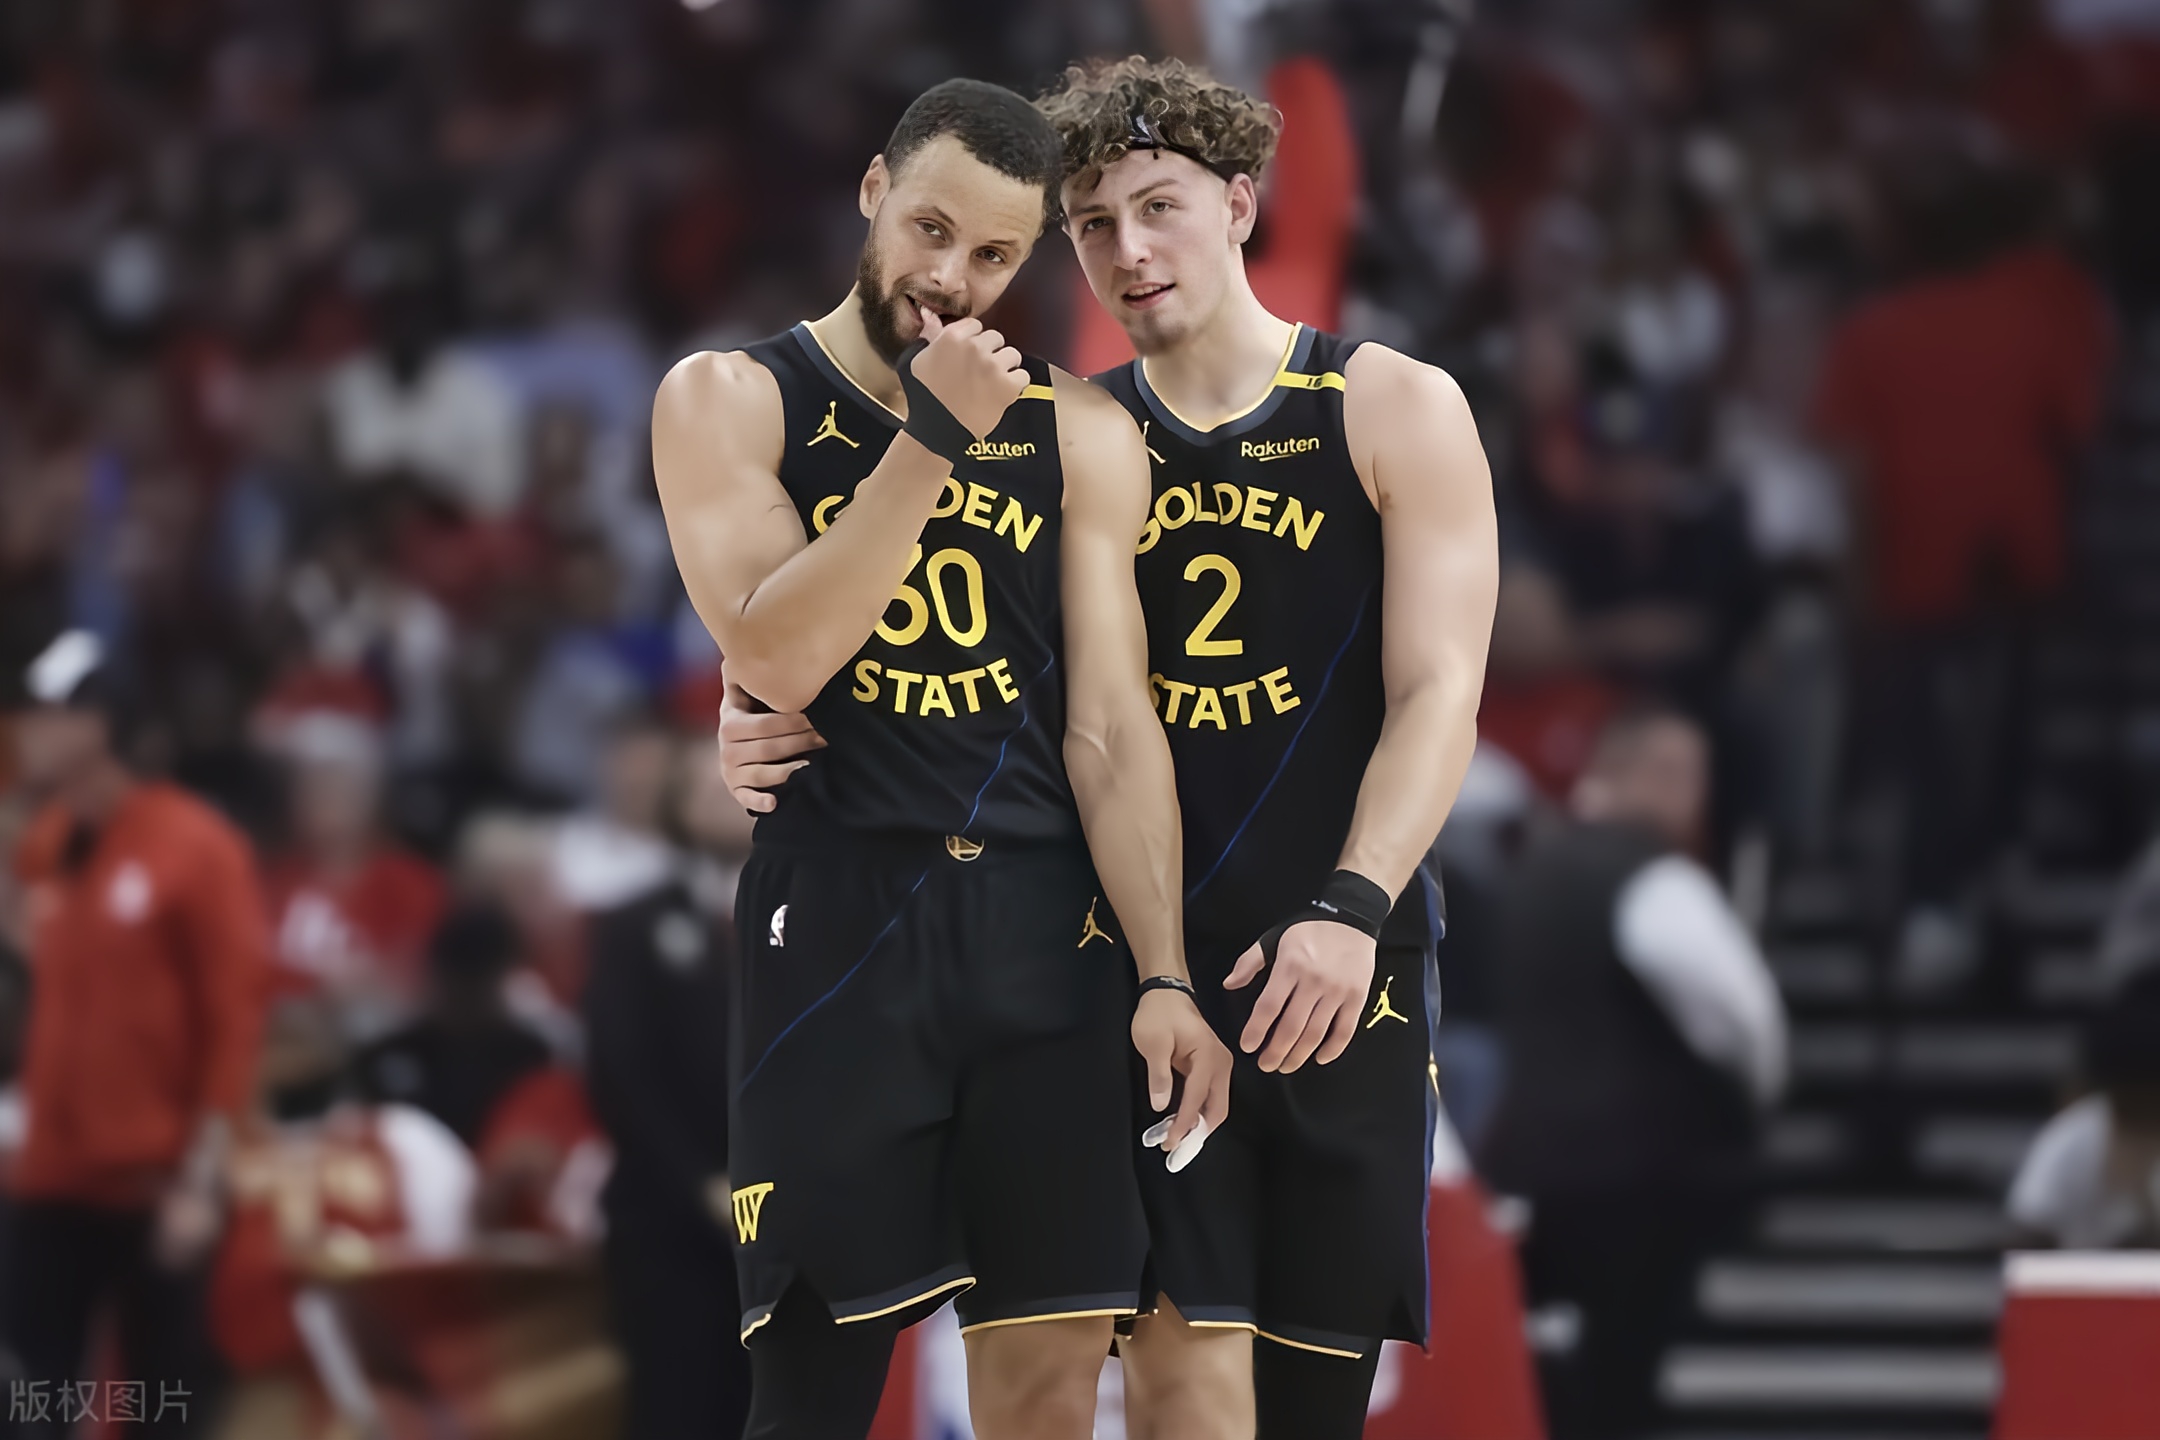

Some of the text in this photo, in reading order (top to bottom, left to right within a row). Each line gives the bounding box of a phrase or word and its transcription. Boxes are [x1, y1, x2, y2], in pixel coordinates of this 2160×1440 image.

[965, 439, 1036, 460] akuten
[1241, 437, 1320, 461] Rakuten
[1183, 553, 1243, 656] 2
[852, 657, 1020, 718] STATE
